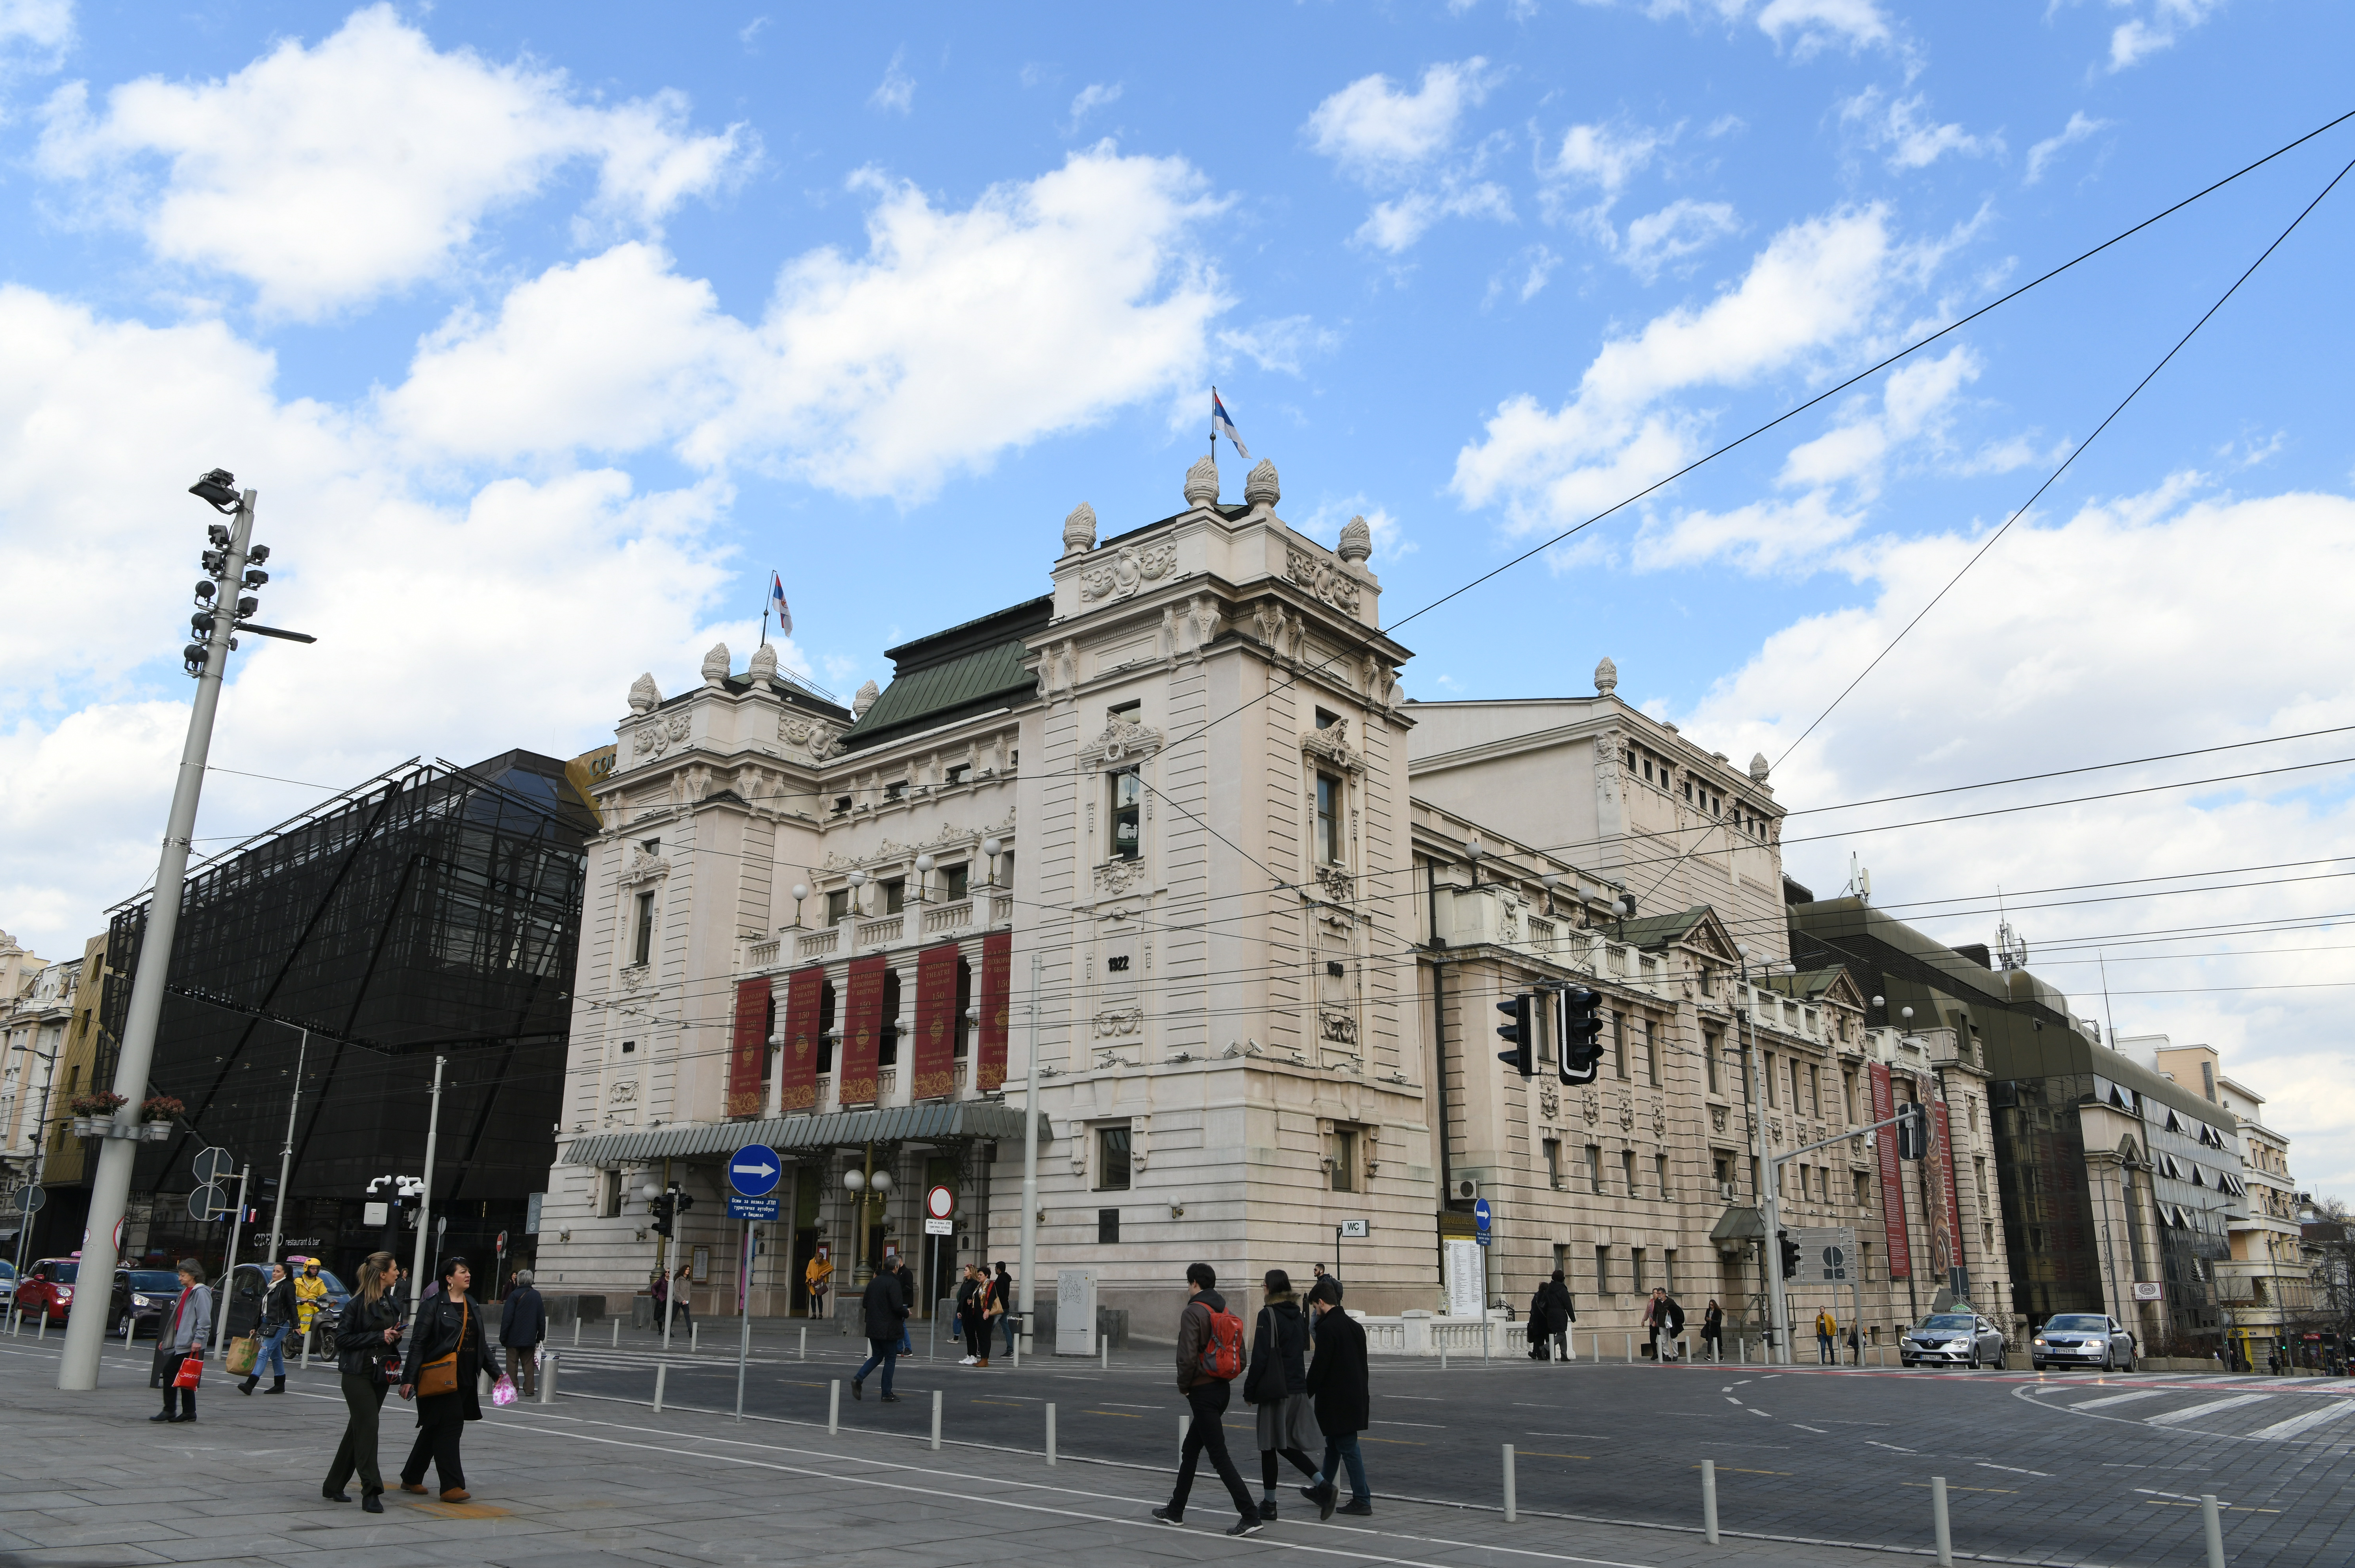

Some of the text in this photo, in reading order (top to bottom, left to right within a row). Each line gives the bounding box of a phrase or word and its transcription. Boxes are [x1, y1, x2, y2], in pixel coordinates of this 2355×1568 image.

[926, 962, 950, 971] NATIONAL
[1108, 956, 1129, 972] 1922
[852, 971, 881, 980] НАРОДНО
[926, 969, 950, 978] THEATRE
[794, 982, 816, 991] NATIONAL
[852, 979, 880, 988] ПОЗОРИШТЕ
[931, 978, 950, 986] BELGRADE
[997, 979, 1010, 988] 150
[794, 990, 816, 998] THEATRE
[857, 987, 880, 995] БЕОГРАДУ
[933, 991, 944, 1000] 150
[741, 992, 765, 1001] НАРОДНО
[741, 1000, 765, 1008] ПОЗОРИШТЕ
[859, 1001, 871, 1010] 150
[745, 1007, 764, 1015] БЕОГРАДУ
[798, 1011, 809, 1019] 150
[254, 1233, 283, 1246] CREO
[308, 1237, 311, 1246] &
